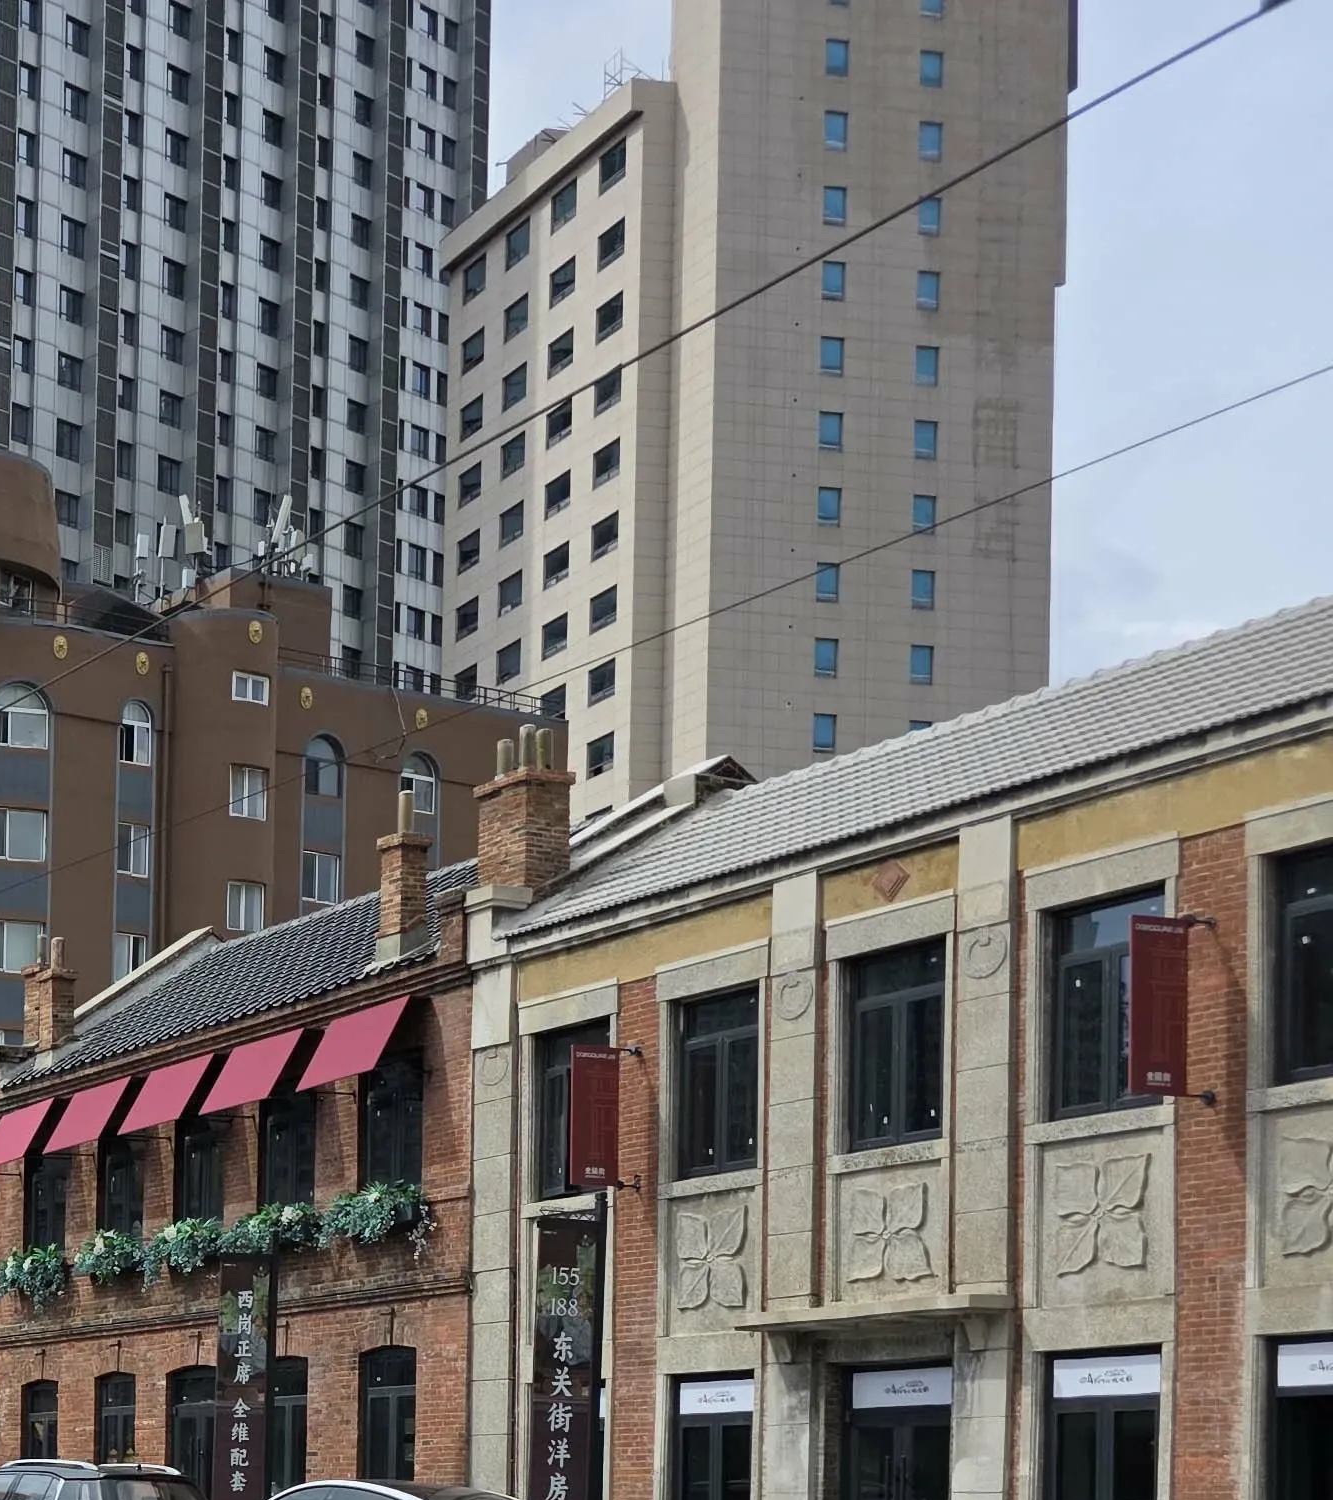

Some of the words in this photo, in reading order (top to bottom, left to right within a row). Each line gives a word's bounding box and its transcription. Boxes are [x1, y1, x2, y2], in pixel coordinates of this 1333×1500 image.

[551, 1267, 581, 1286] 155
[549, 1298, 579, 1317] 188
[234, 1290, 254, 1386] 西岗正席
[229, 1397, 251, 1493] 全维配套
